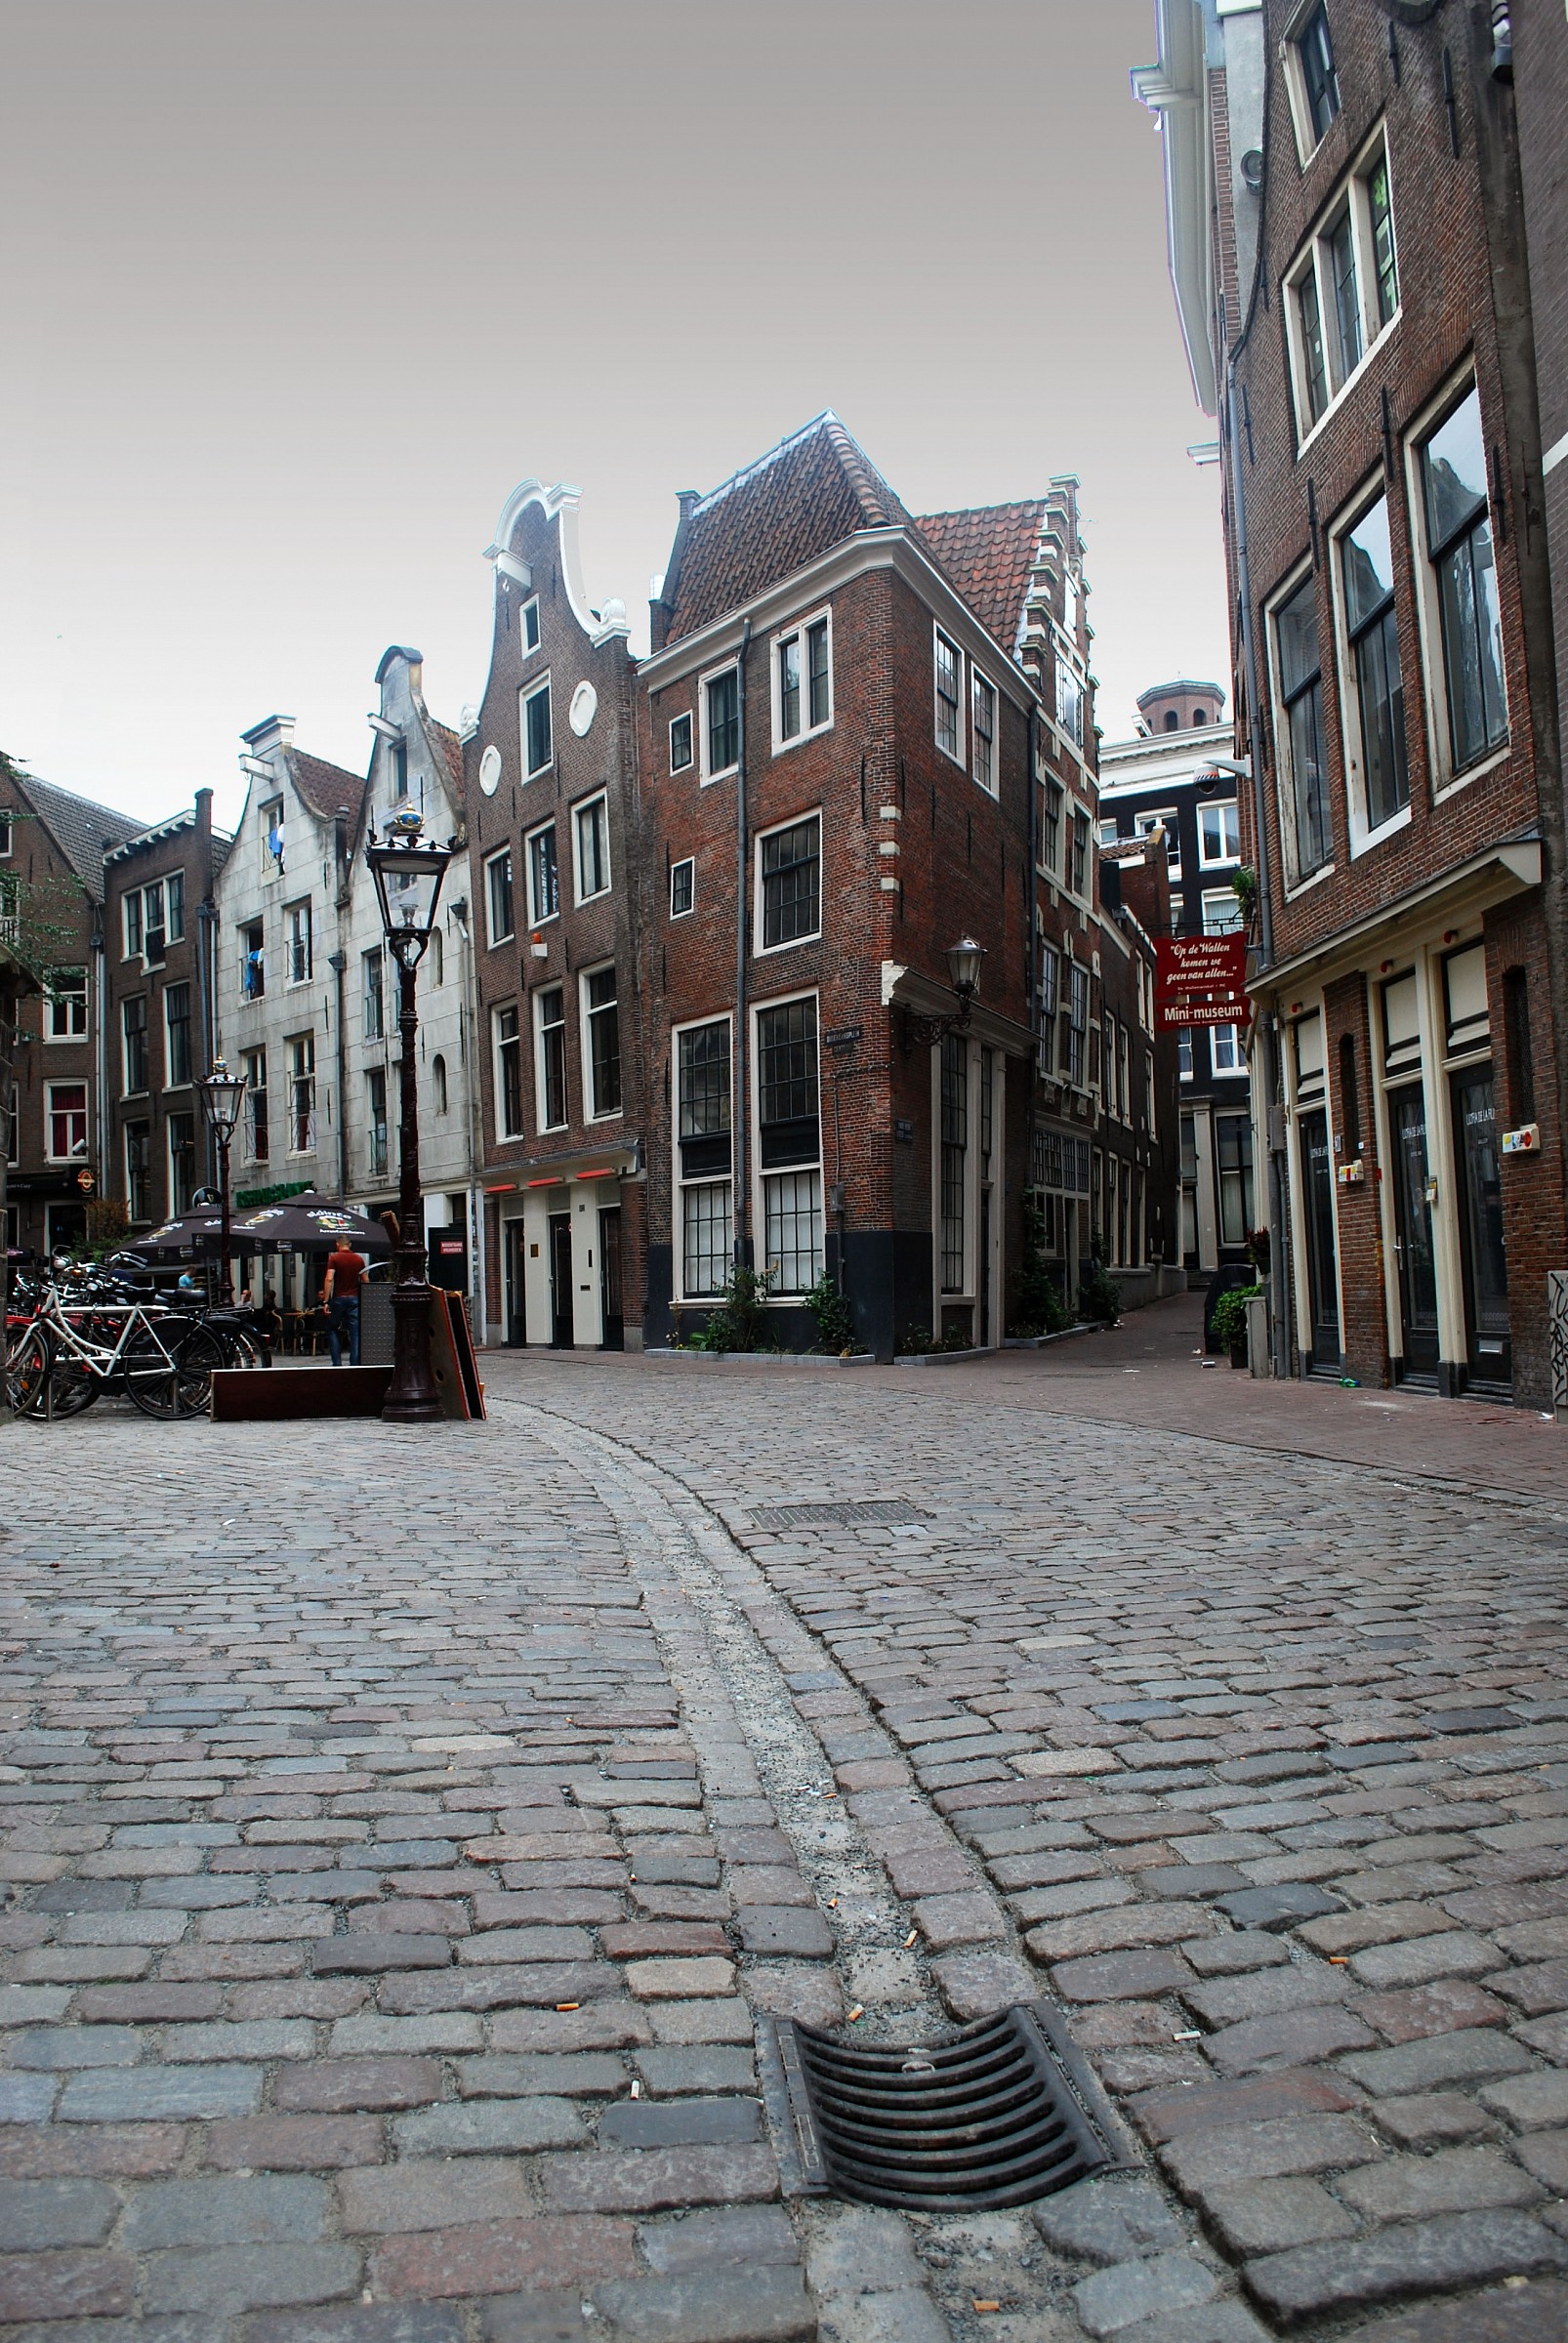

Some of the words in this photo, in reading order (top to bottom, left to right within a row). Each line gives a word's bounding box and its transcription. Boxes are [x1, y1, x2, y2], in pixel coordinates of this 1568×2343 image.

[1188, 945, 1198, 955] de
[1199, 942, 1230, 954] Wallen
[1180, 958, 1208, 968] komen
[1166, 971, 1187, 985] geen
[1165, 1006, 1243, 1020] Mini-museum
